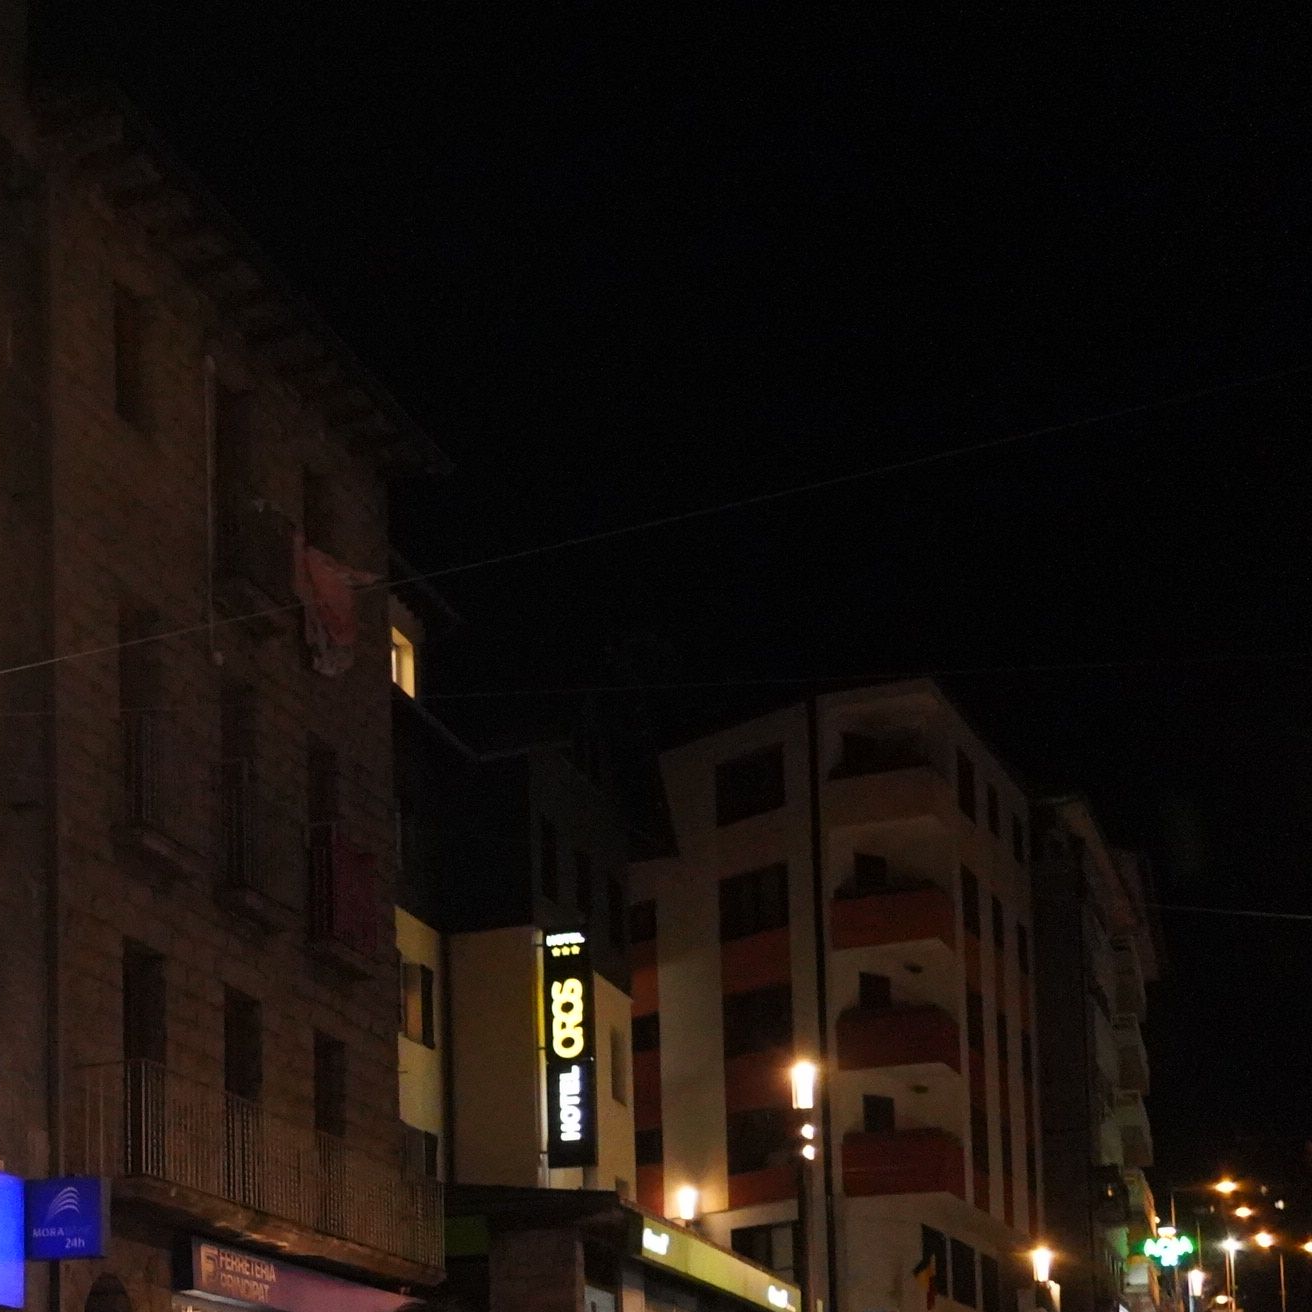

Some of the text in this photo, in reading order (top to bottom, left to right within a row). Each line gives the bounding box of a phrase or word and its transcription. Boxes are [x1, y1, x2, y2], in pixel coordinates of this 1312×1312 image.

[546, 932, 585, 947] HOTEL
[551, 977, 584, 1059] OROS
[559, 1064, 582, 1142] HOTEL
